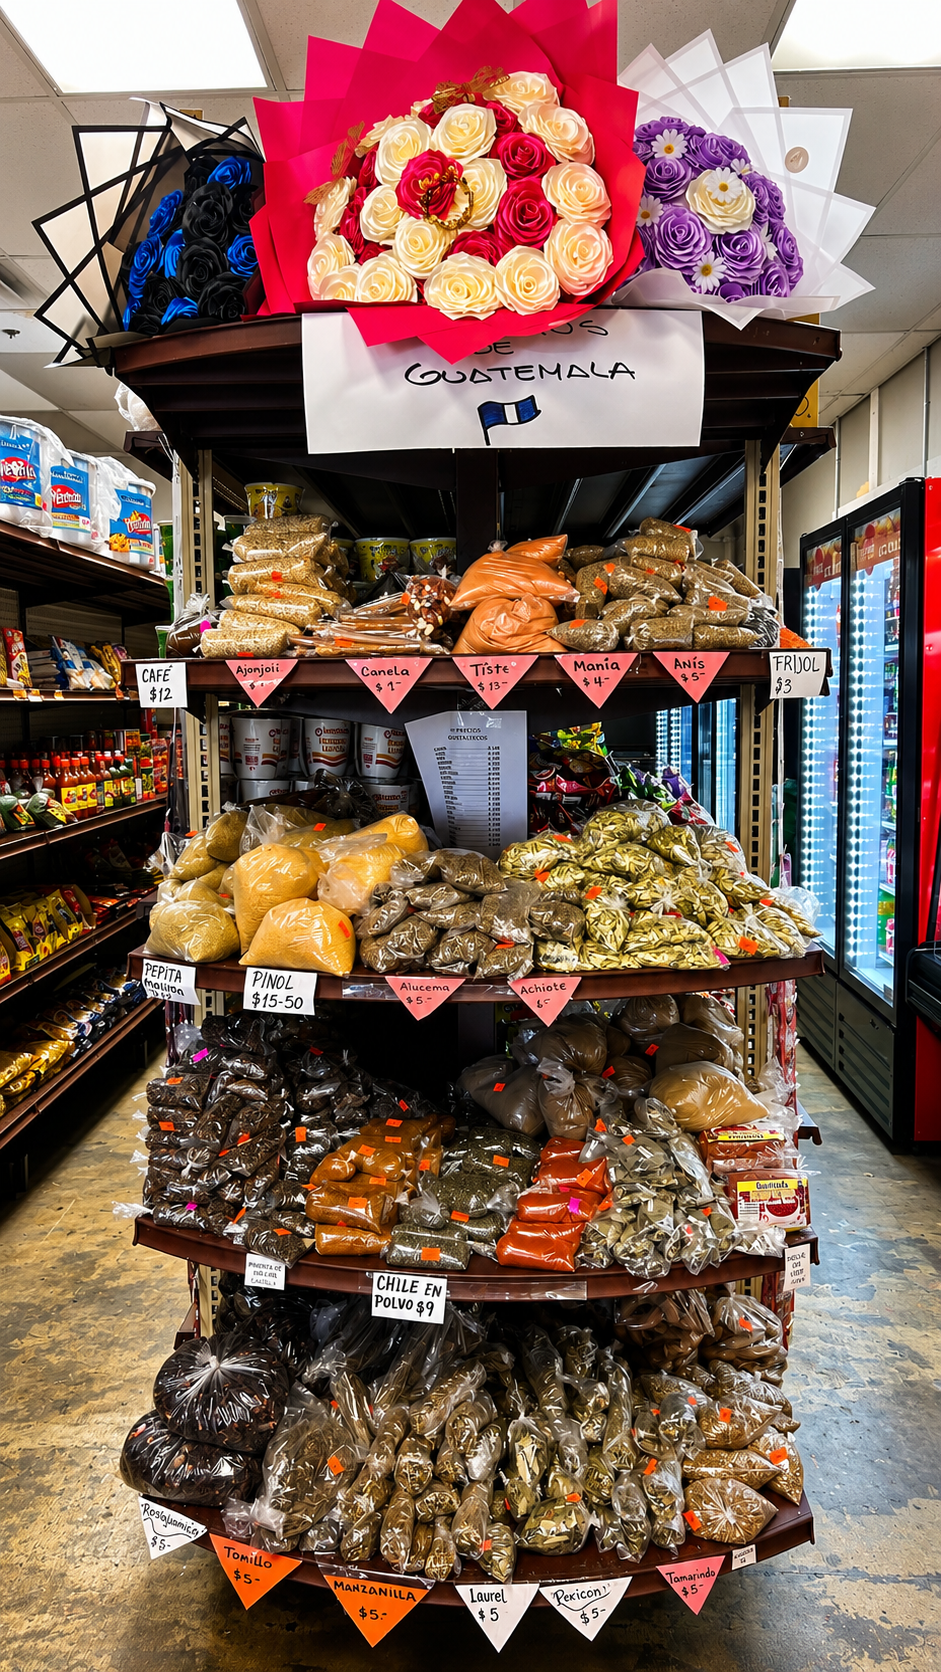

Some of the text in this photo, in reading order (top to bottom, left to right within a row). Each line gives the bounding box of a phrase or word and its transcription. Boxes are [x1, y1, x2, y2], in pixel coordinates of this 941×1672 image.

[404, 361, 635, 386] GUATEMALA
[142, 664, 173, 683] CAFÉ
[361, 665, 410, 677] Canela
[772, 654, 821, 675] FRIJOL
[150, 686, 173, 703] $12
[775, 676, 792, 695] $3
[252, 970, 294, 990] PINOL
[400, 982, 450, 992] Alucema
[521, 982, 567, 995] Achiote
[252, 991, 304, 1010] $15-50
[377, 1275, 443, 1298] CHILE EN
[374, 1294, 414, 1311] POLVO
[223, 1545, 273, 1569] Tomillo
[665, 1567, 716, 1584] Tamarindo
[470, 1588, 508, 1604] Laurel
